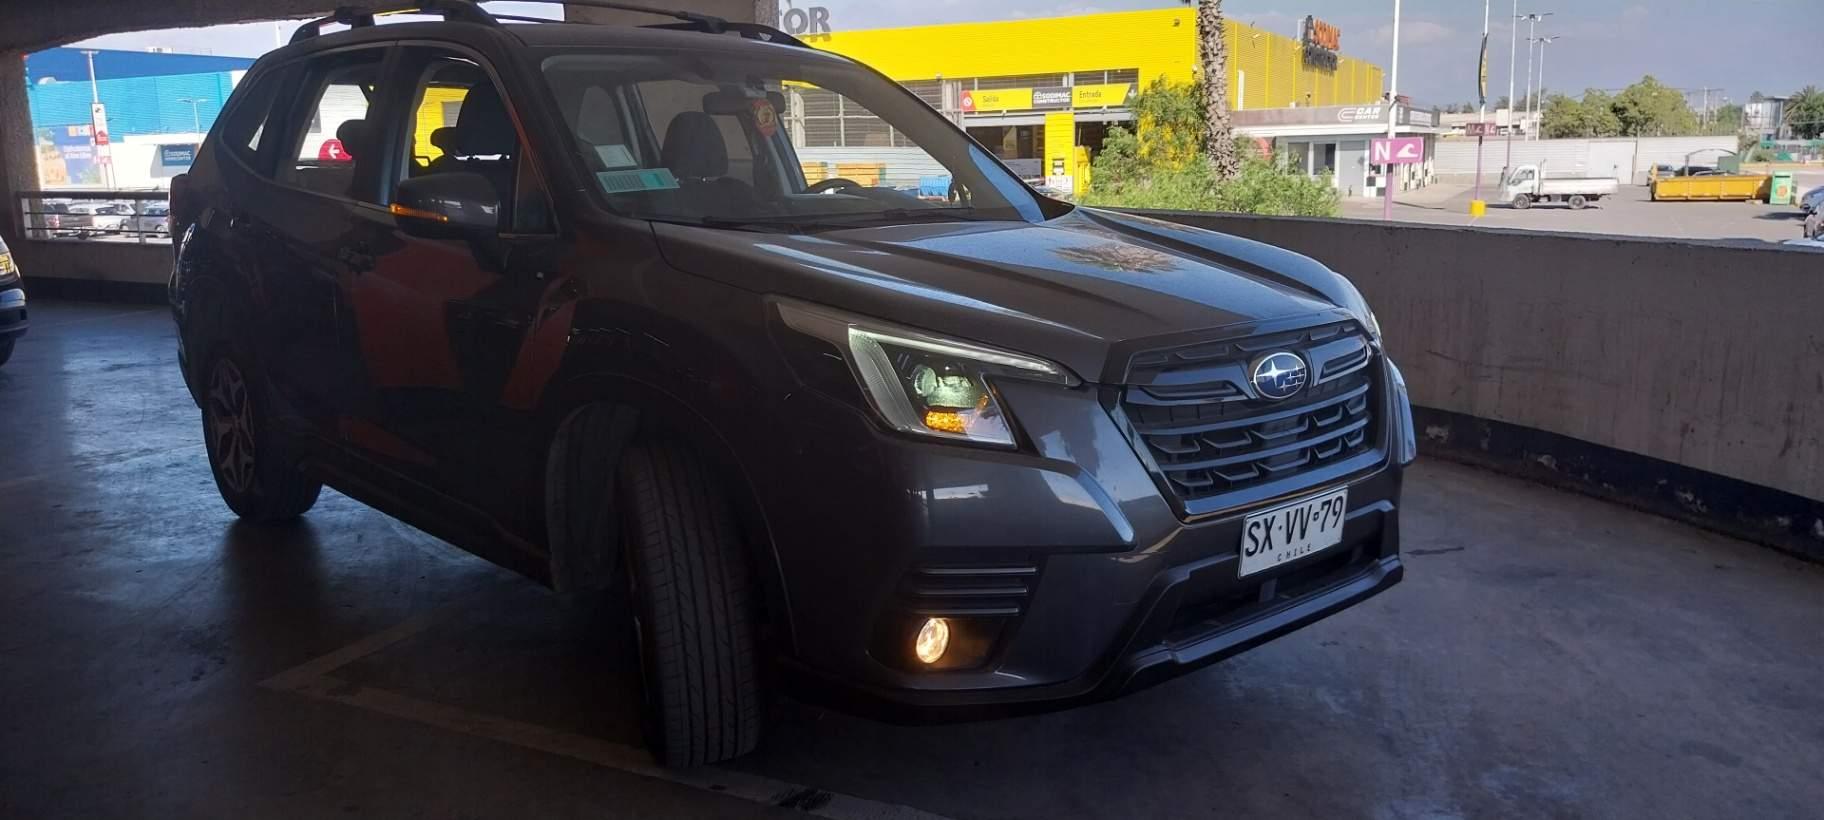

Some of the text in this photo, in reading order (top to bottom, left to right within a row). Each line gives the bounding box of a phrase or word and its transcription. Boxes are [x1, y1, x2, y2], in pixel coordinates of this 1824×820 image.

[779, 6, 831, 35] OR
[982, 95, 999, 103] Salida
[1079, 90, 1102, 98] Entrada
[1357, 107, 1381, 115] CAR
[1374, 141, 1391, 161] N
[1277, 543, 1312, 562] CHILE
